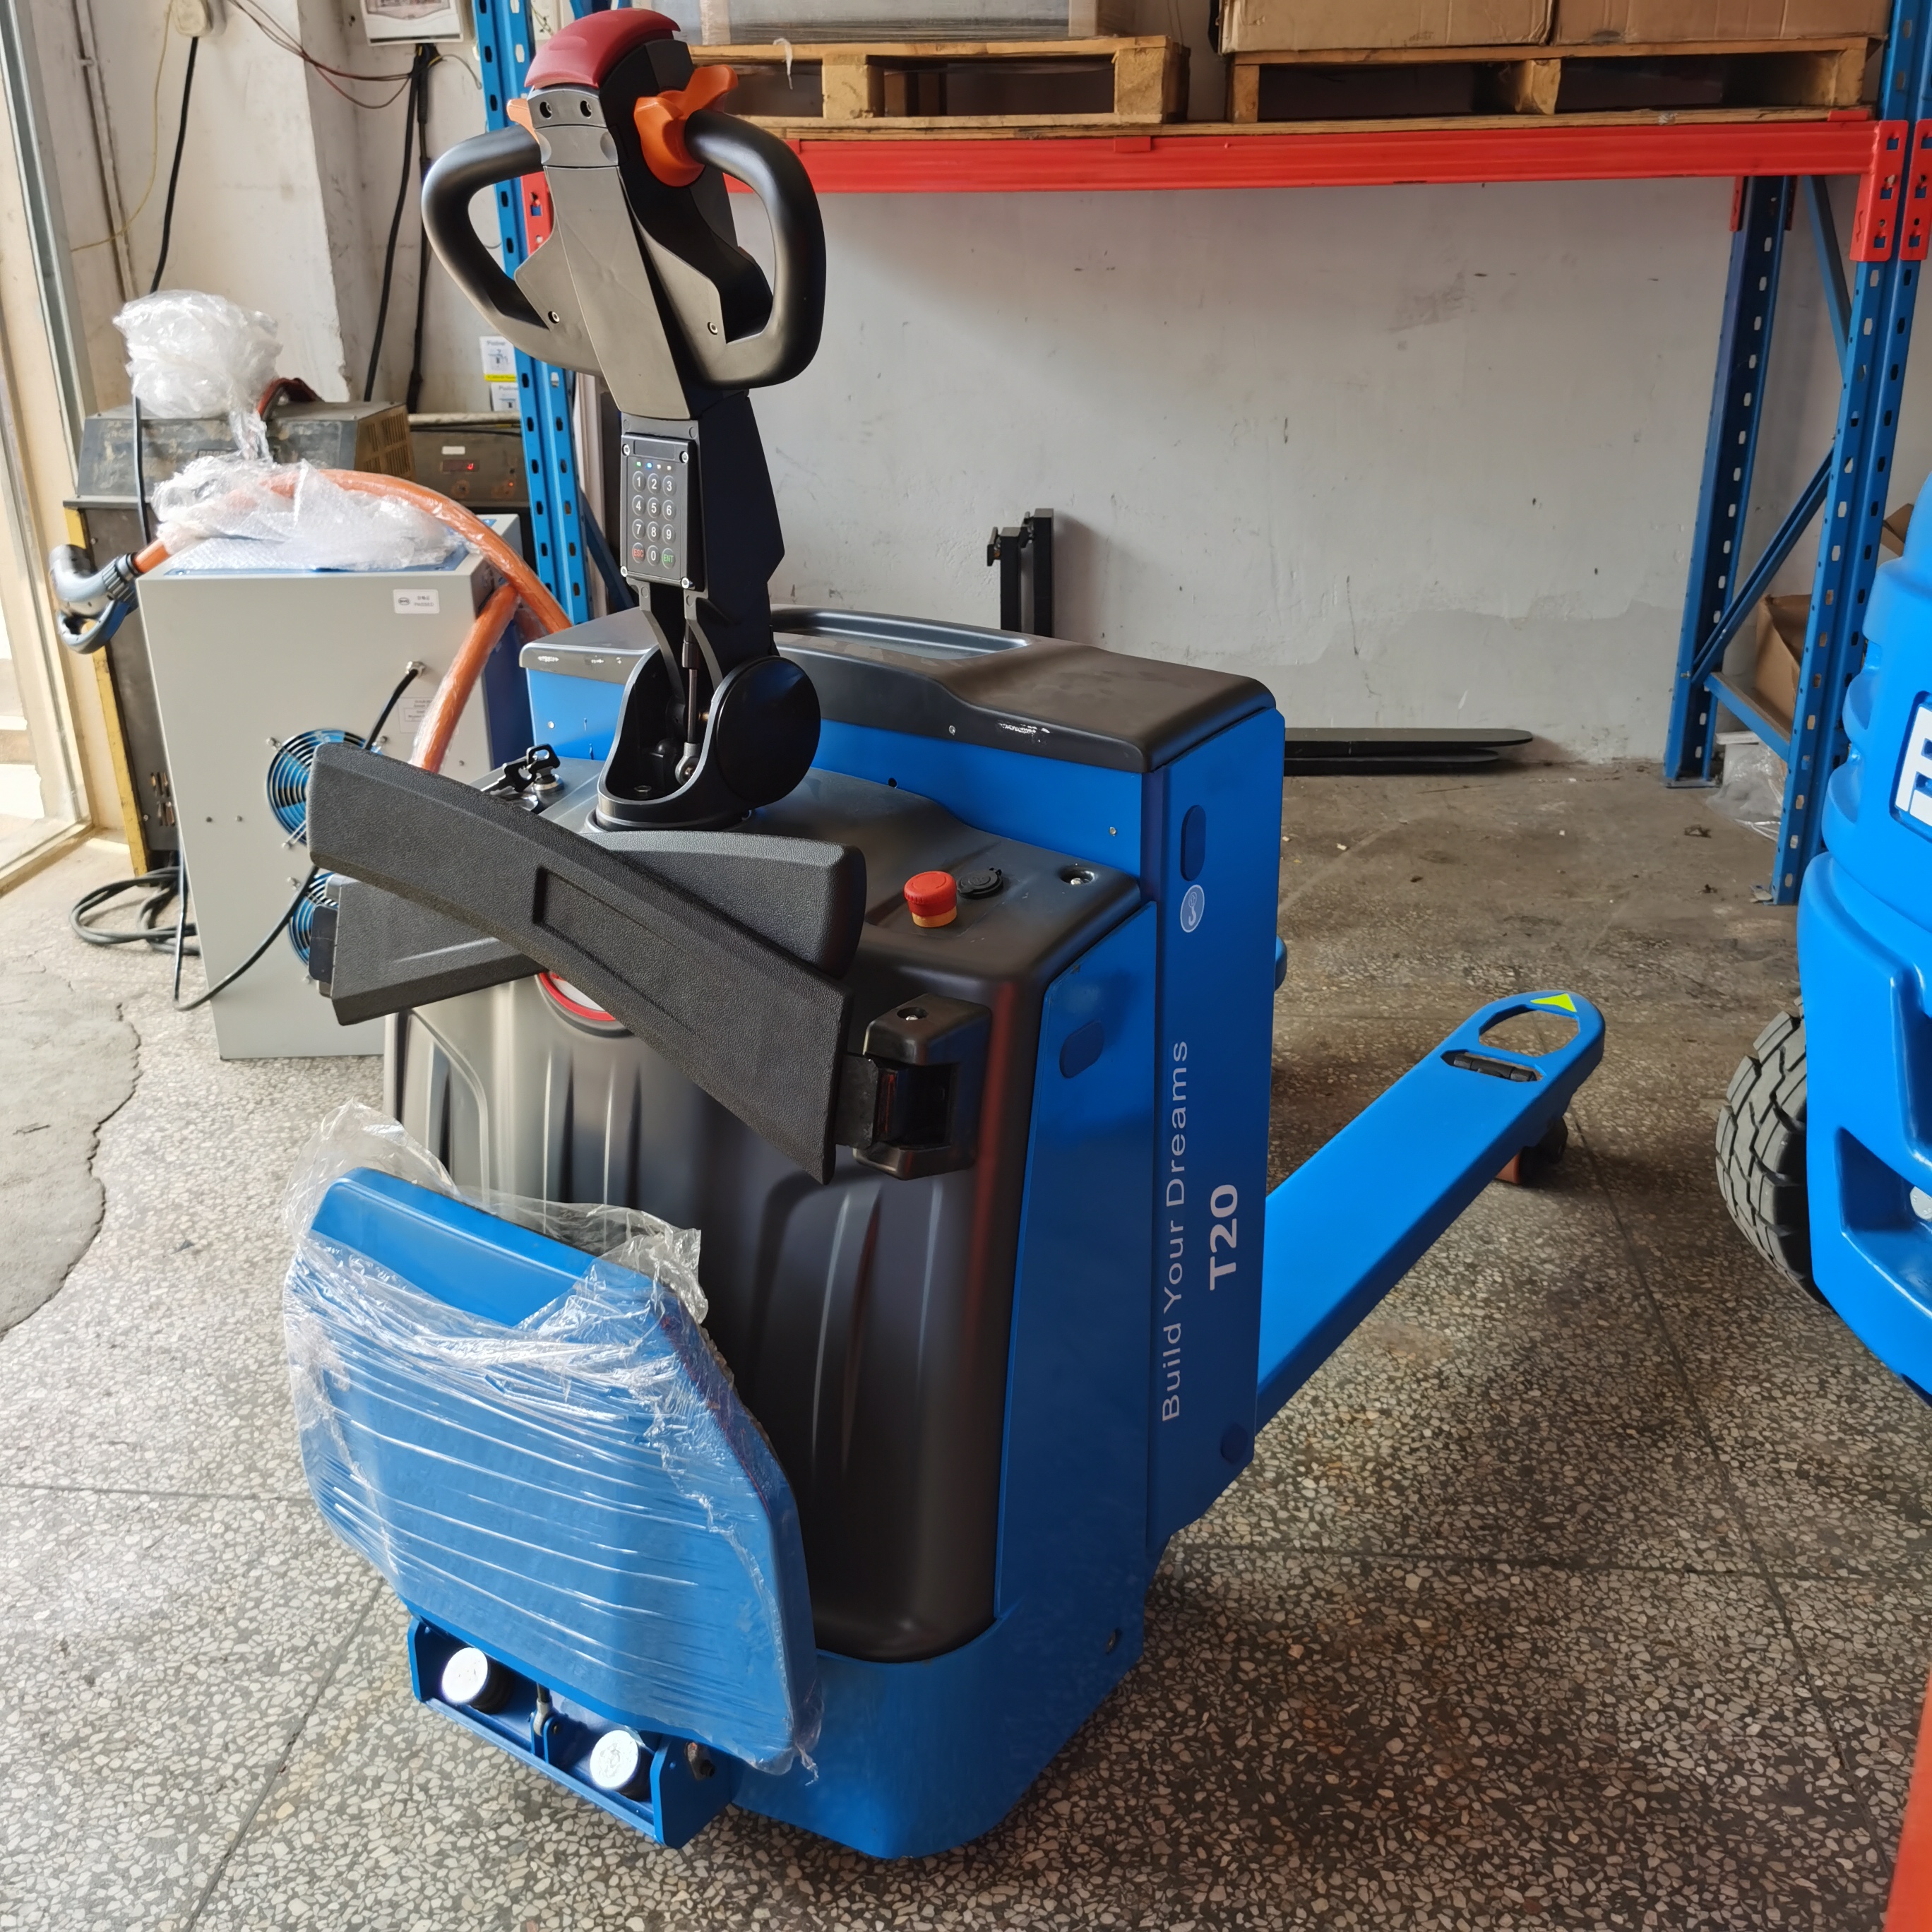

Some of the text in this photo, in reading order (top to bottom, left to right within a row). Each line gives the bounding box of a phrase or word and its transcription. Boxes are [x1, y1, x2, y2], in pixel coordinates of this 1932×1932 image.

[637, 477, 672, 491] 1 2 3
[636, 500, 672, 515] 4 5 6
[636, 523, 672, 539] 7 8 9
[633, 549, 674, 563] ESC 0 ENT
[1162, 1041, 1188, 1421] Build Your Dreams
[1210, 1184, 1238, 1291] T20
